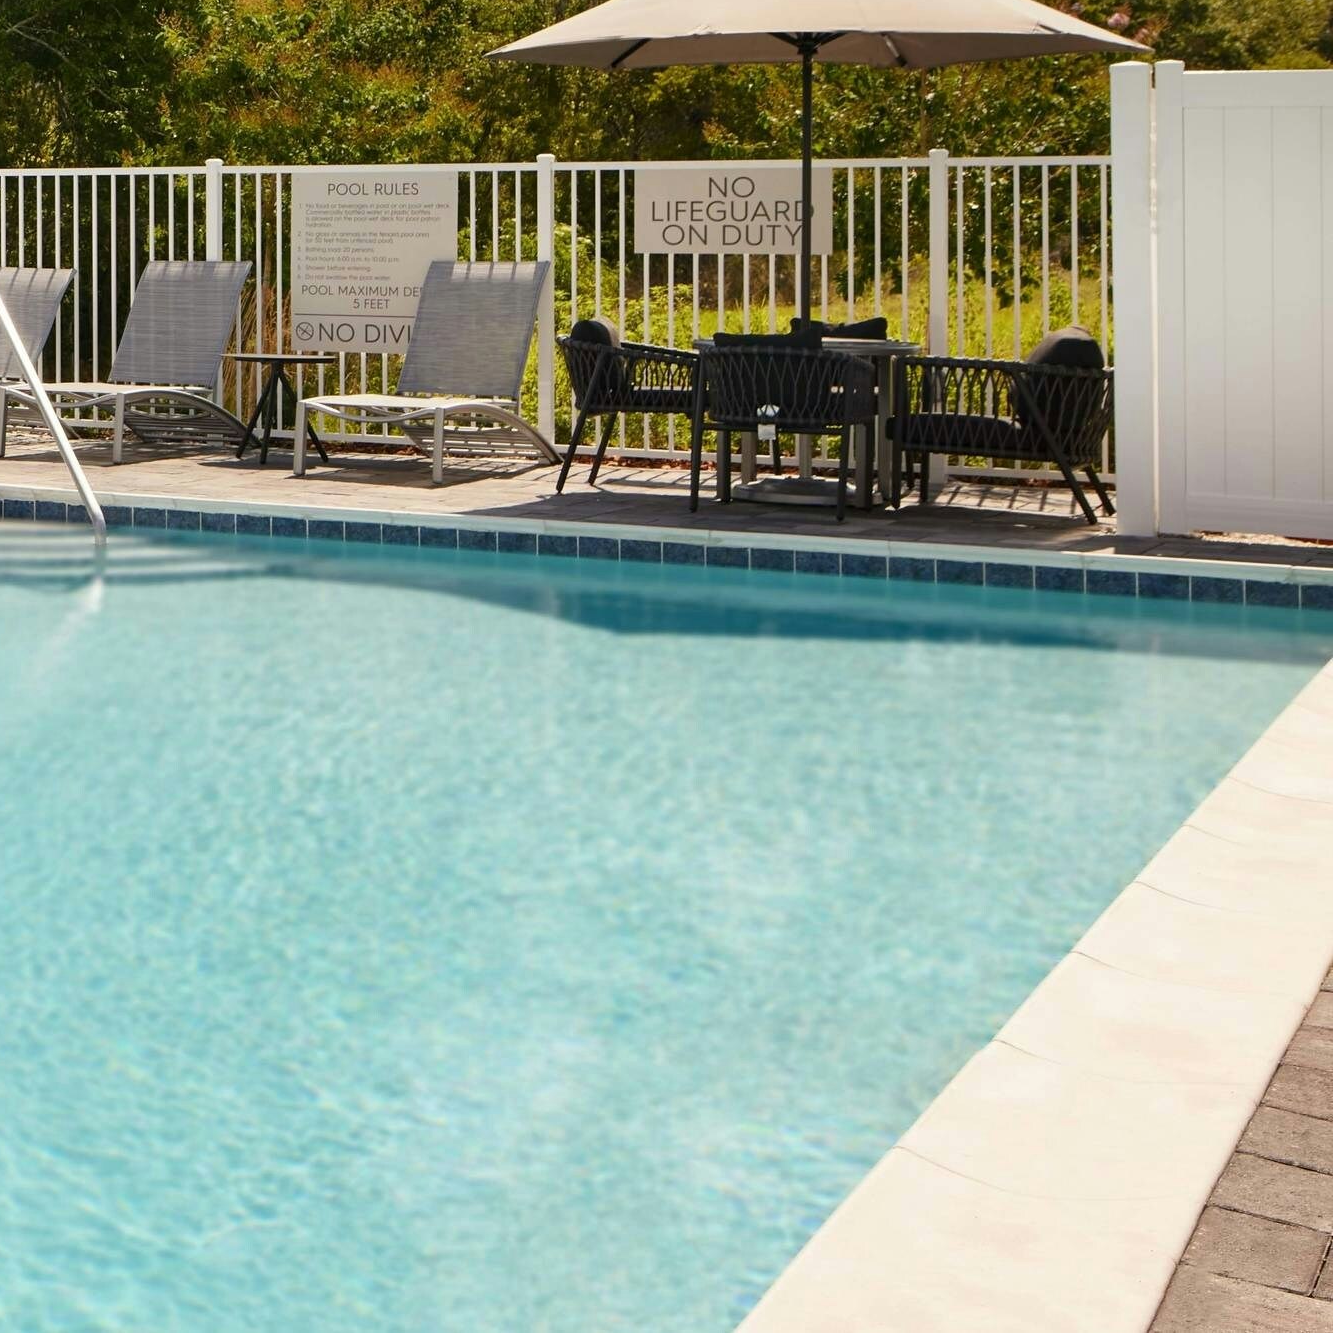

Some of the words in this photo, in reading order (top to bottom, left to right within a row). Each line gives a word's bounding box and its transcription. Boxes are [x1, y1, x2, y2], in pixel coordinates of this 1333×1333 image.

[327, 183, 369, 196] POOL
[374, 182, 419, 196] RULES
[708, 176, 755, 198] NO
[662, 224, 708, 246] ON
[722, 224, 803, 246] DUTY
[301, 285, 333, 296] POOL
[338, 286, 399, 297] MAXIMUM
[353, 299, 360, 309] 5
[364, 299, 390, 309] FEET
[318, 323, 355, 342] NO
[365, 324, 411, 344] DIVI
